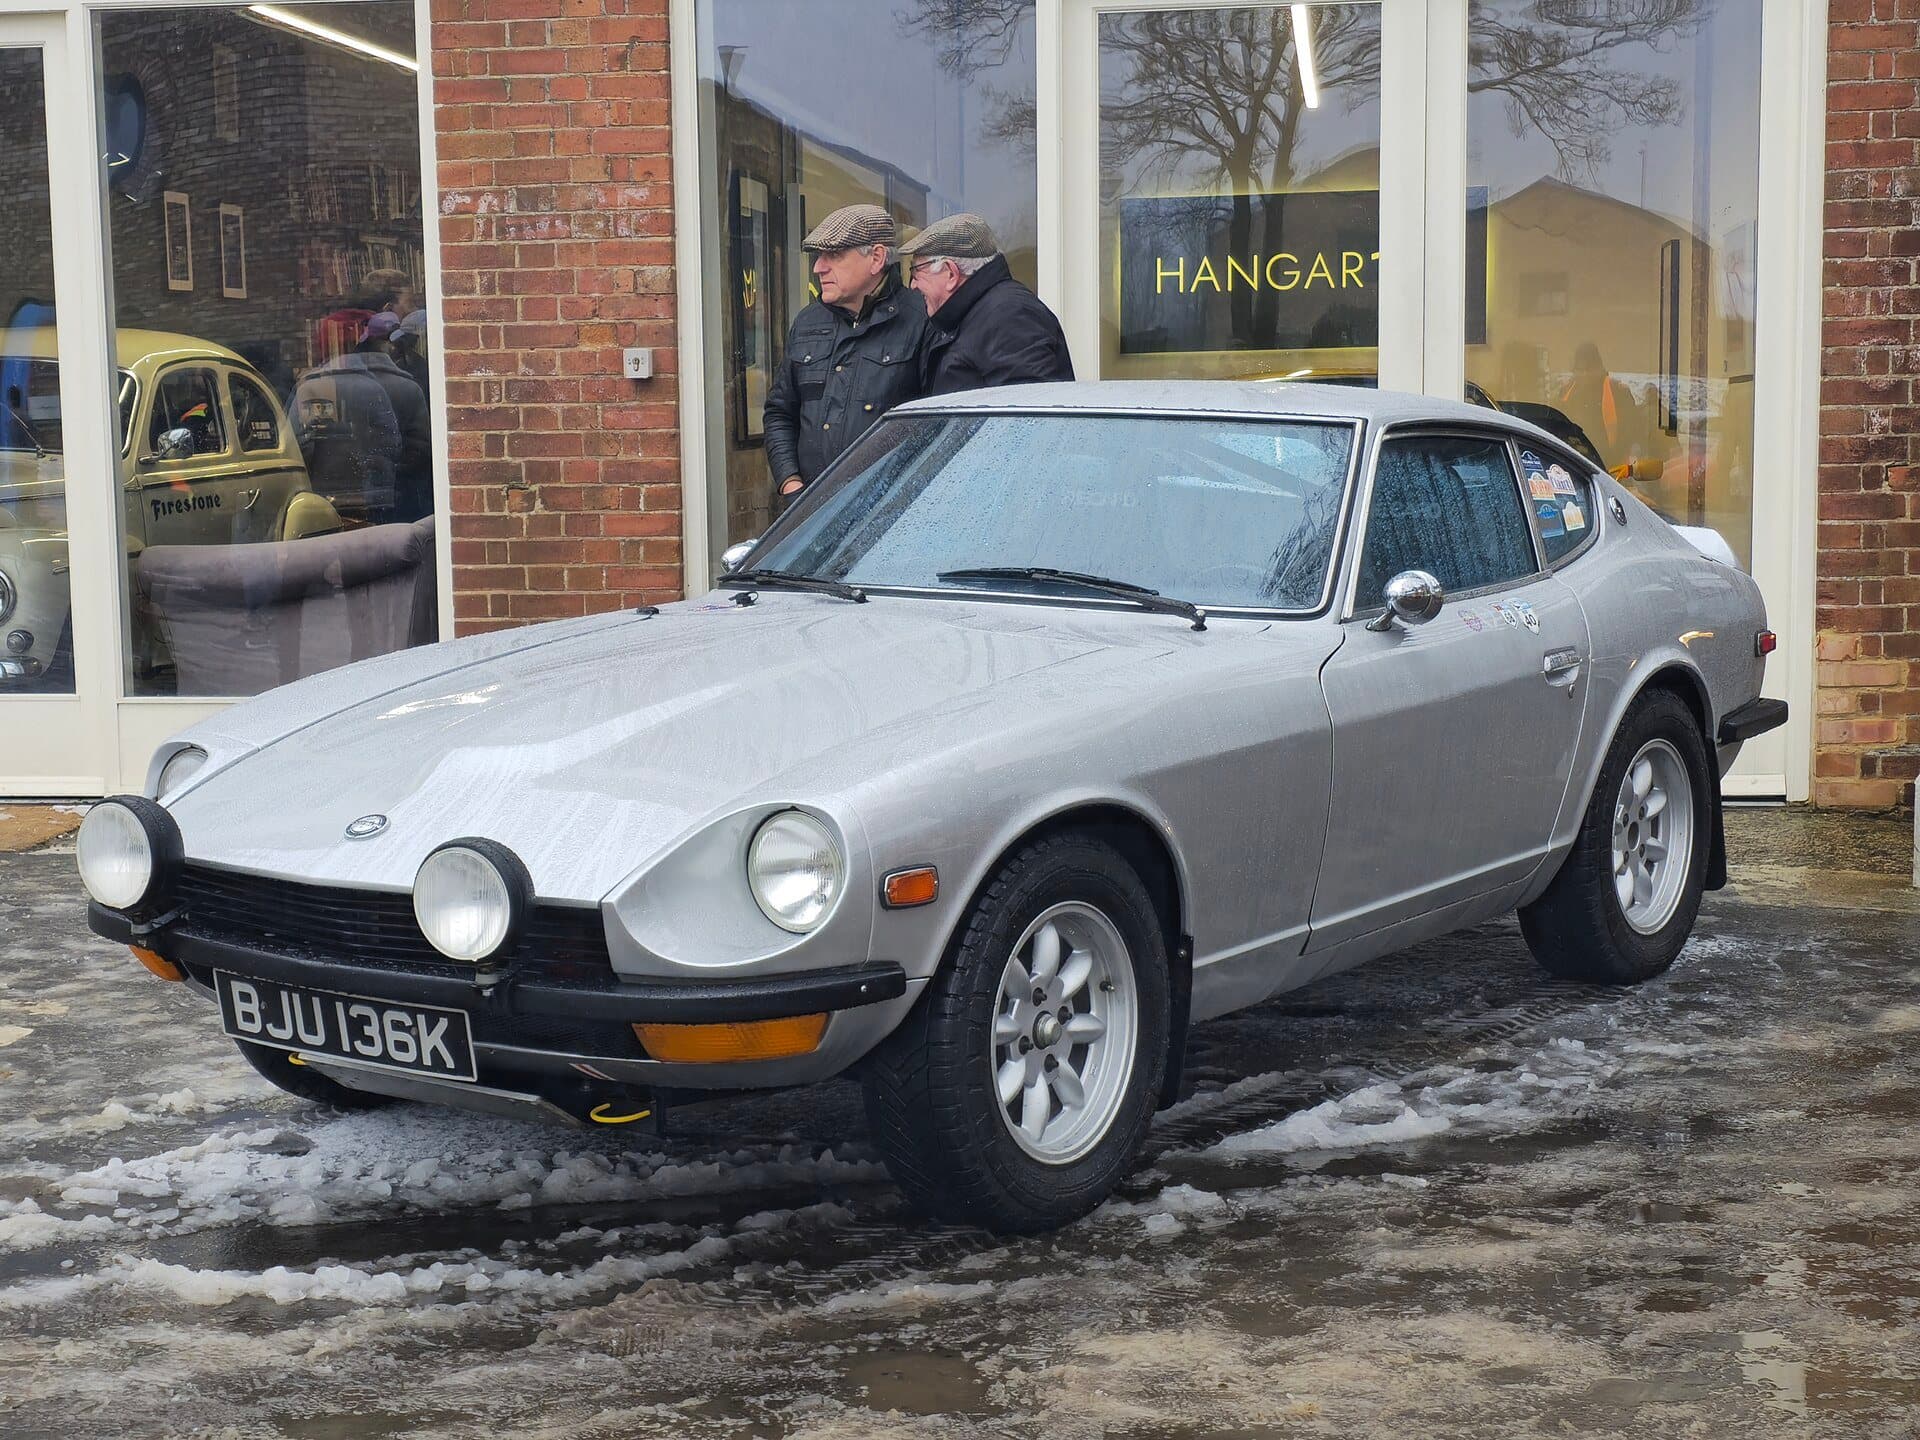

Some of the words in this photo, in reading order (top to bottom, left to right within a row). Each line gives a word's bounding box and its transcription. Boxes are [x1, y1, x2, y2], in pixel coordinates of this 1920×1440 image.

[1156, 252, 1380, 294] HANGAR
[151, 494, 221, 521] Firestone
[230, 980, 326, 1046] BJU
[335, 1001, 455, 1069] 136K
